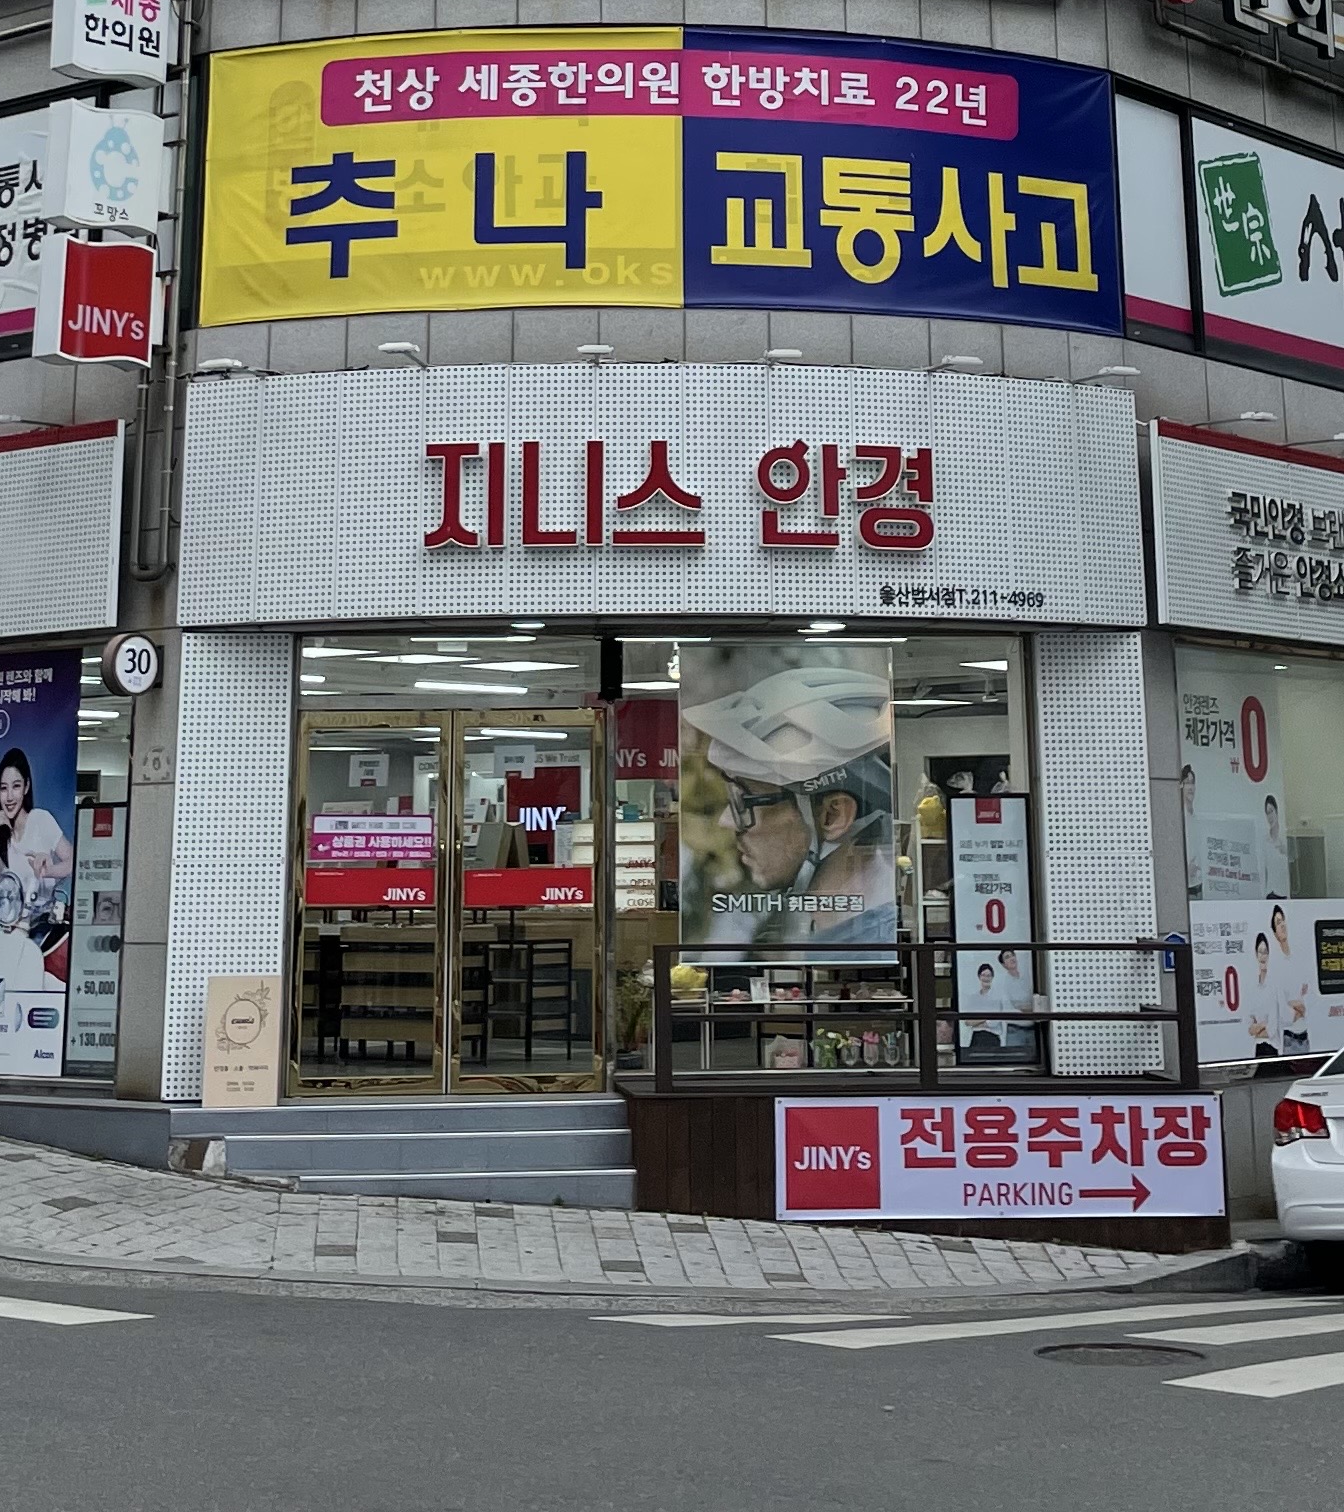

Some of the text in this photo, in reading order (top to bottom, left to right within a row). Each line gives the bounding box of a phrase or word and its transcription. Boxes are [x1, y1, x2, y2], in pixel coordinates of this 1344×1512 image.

[84, 12, 161, 58] 한의원
[354, 59, 989, 128] 천상 세종한의원 한방치료 22년
[711, 150, 1099, 292] 교통사고
[68, 303, 145, 341] JINY's
[424, 438, 935, 552] 지니스 안경
[1226, 490, 1305, 545] 국민안경
[1232, 546, 1291, 596] 즐거운
[124, 648, 151, 675] 30
[1183, 693, 1219, 714] 안경렌즈
[1185, 717, 1236, 749] 체감가격
[1240, 695, 1268, 783] 0
[804, 768, 847, 792] SMITH
[382, 888, 426, 901] JINY's
[541, 888, 584, 901] JINY's
[711, 893, 864, 913] SMITH 취급전문점
[33, 1049, 54, 1059] Alcon
[899, 1105, 1212, 1169] 전용주차장
[793, 1146, 872, 1171] JINY's
[963, 1182, 1074, 1207] PARKING
